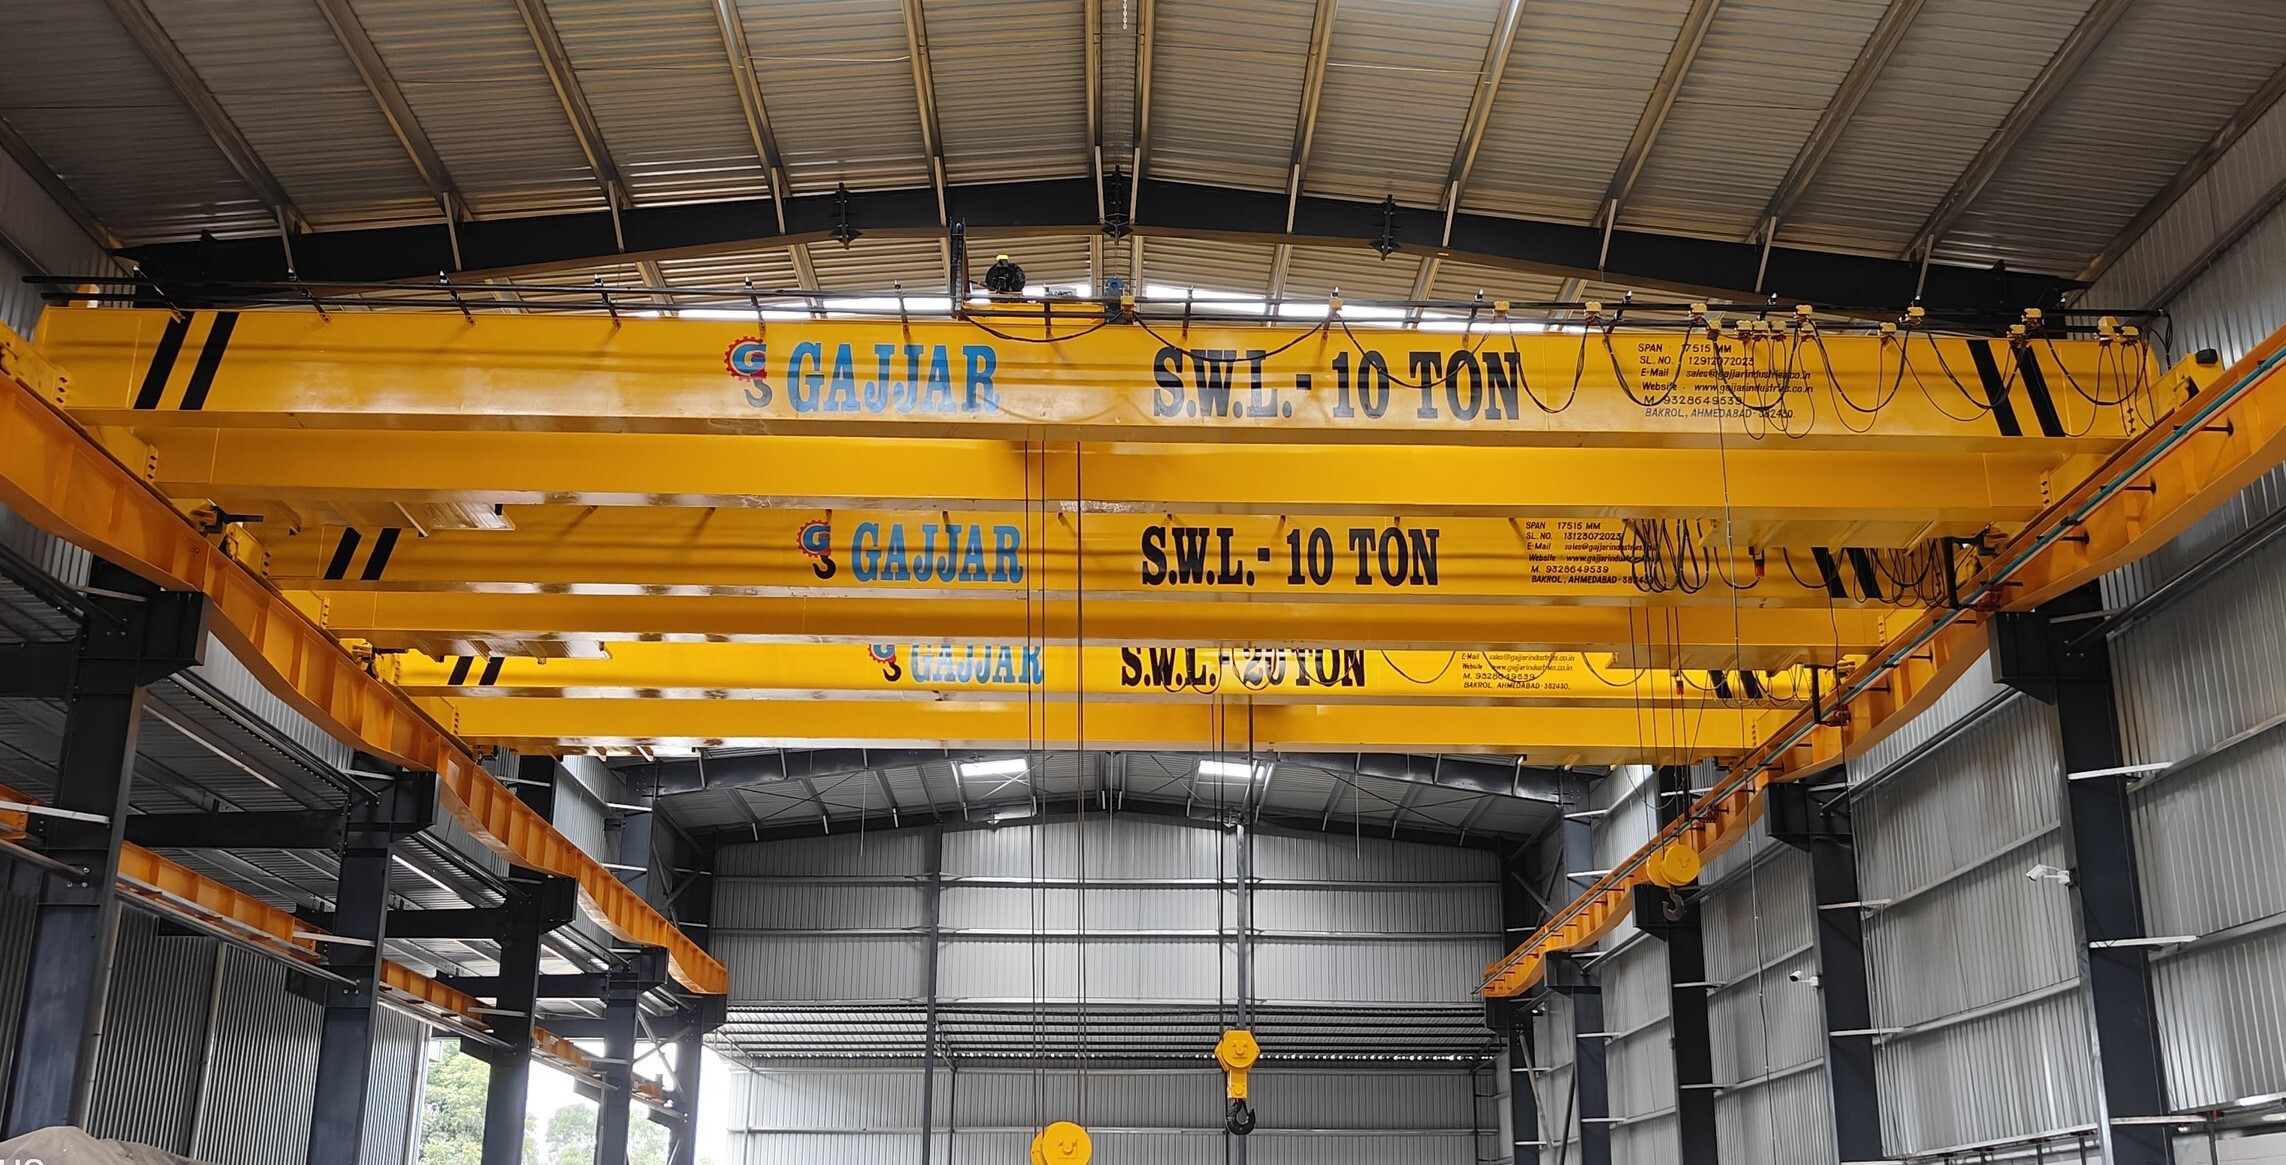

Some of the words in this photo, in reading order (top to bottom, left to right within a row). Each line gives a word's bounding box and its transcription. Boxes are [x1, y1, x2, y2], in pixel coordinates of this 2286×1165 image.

[1638, 343, 1663, 352] SPAN
[1682, 344, 1711, 352] 7515
[1641, 368, 1669, 376] E-Mail
[787, 341, 999, 414] GAJJAR
[1332, 350, 1390, 419] 10
[1409, 350, 1520, 420] TON
[1645, 408, 1688, 418] BAKROL,
[1525, 522, 1546, 530] SPAN
[1558, 522, 1583, 530] 17515
[1585, 522, 1601, 530] MM
[1564, 532, 1622, 540] 13123072023
[851, 522, 1024, 583] GAJJAR
[1287, 527, 1333, 585] 10
[1350, 527, 1440, 586] TON
[1529, 552, 1556, 561] Website
[1546, 565, 1609, 573] 9328649539
[1532, 575, 1566, 584] BAKROL,
[911, 644, 1043, 684] GAJJAR
[1294, 648, 1366, 688] TON
